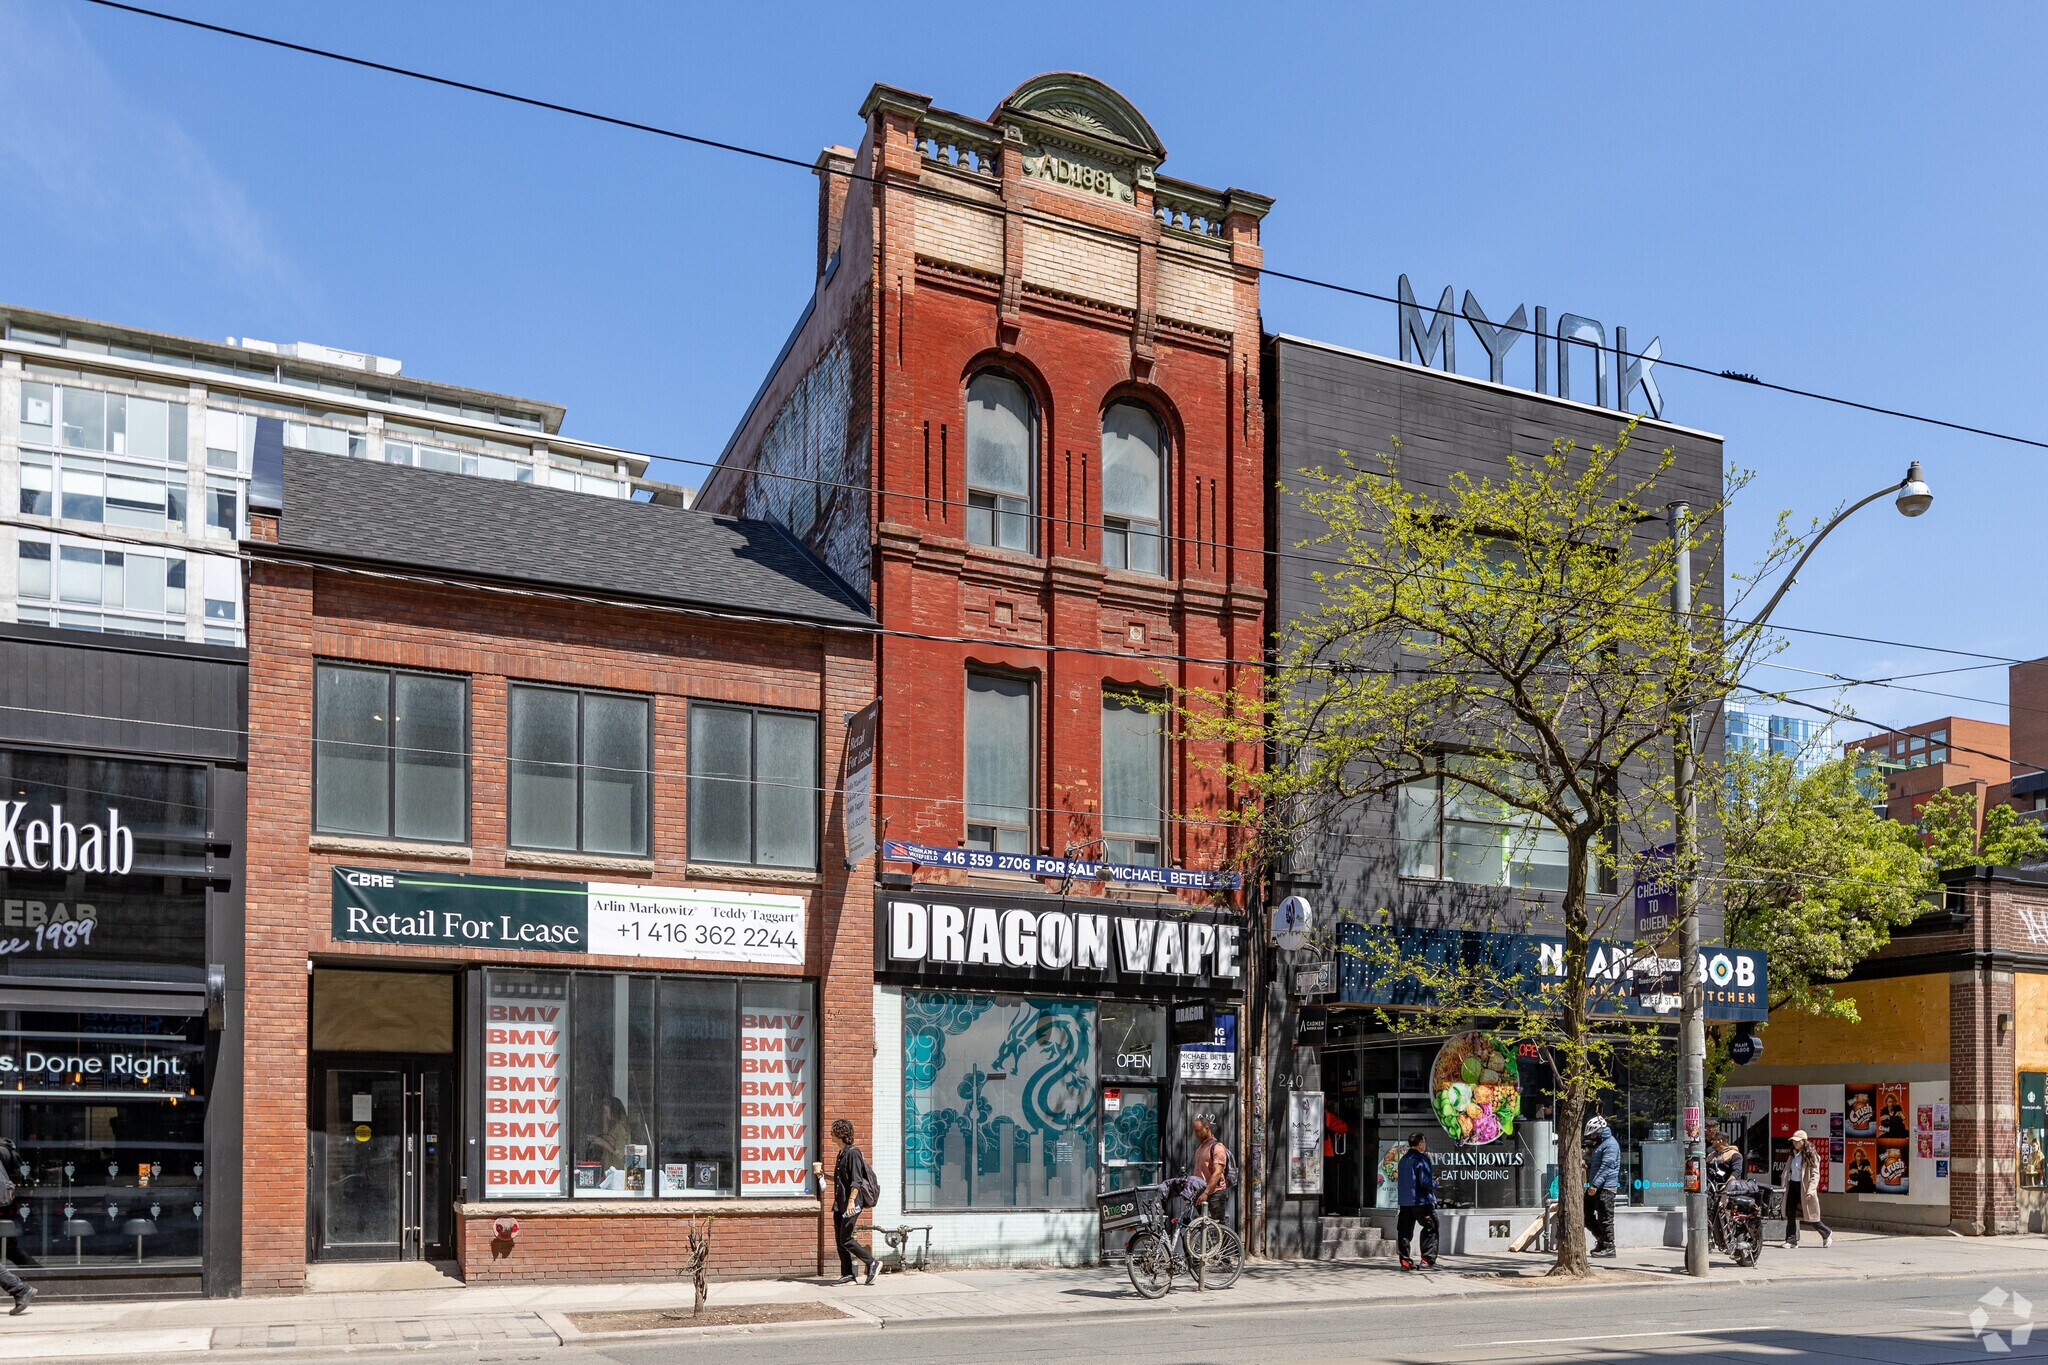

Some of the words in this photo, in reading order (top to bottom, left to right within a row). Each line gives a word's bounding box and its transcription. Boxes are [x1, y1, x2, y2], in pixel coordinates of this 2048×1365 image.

[850, 728, 866, 751] Retail
[848, 755, 858, 770] For
[858, 746, 872, 765] Lease
[0, 800, 134, 875] Kebab
[943, 851, 966, 865] 416
[969, 853, 994, 867] 359
[998, 856, 1031, 870] 2706
[1036, 859, 1066, 874] FOR
[1110, 867, 1167, 883] MICHAEL
[346, 873, 395, 888] CBRE
[1637, 884, 1670, 899] CHEERS
[594, 900, 626, 912] Arlin
[711, 906, 749, 922] Teddy
[1648, 899, 1659, 914] TO
[346, 906, 437, 937] Retail
[442, 912, 494, 939] For
[499, 915, 580, 944] Lease
[1640, 914, 1668, 932] QUEEN
[36, 918, 94, 951] 1989
[617, 921, 640, 941] +1
[648, 922, 688, 944] 416
[695, 925, 736, 946] 362
[743, 928, 798, 950] 2244
[888, 902, 1108, 970] DRAGON
[1115, 917, 1241, 979] VAPE
[1702, 990, 1756, 1004] ITCHEN
[486, 1006, 561, 1022] BMV
[741, 1014, 805, 1030] BMV
[1175, 1005, 1204, 1023] DRAGON
[486, 1028, 561, 1046] BMV
[741, 1036, 805, 1053] BMV
[1518, 1043, 1539, 1058] OPE
[26, 1052, 103, 1073] Done
[110, 1054, 187, 1080] Right.
[486, 1051, 561, 1068] BMV
[741, 1058, 805, 1074] BMV
[1116, 1053, 1151, 1069] OPEN
[1181, 1062, 1194, 1070] 416
[1196, 1062, 1210, 1070] 359
[1212, 1063, 1232, 1071] 2706
[486, 1075, 561, 1092] BMV
[741, 1080, 805, 1097] BMV
[1279, 1073, 1304, 1088] 240
[486, 1097, 561, 1114] BMV
[741, 1101, 807, 1117] BMV
[1849, 1103, 1873, 1123] Crush
[486, 1121, 561, 1138] BMV
[741, 1123, 807, 1140] BMV
[486, 1144, 561, 1161] BMV
[741, 1145, 807, 1161] BMV
[1428, 1152, 1477, 1167] AFGHAN
[1479, 1152, 1524, 1167] BOWLS
[486, 1168, 561, 1185] BMV
[741, 1167, 807, 1184] BMV
[1441, 1169, 1459, 1181] EAT
[1460, 1169, 1509, 1181] UNBORING
[1880, 1158, 1905, 1178] Crush
